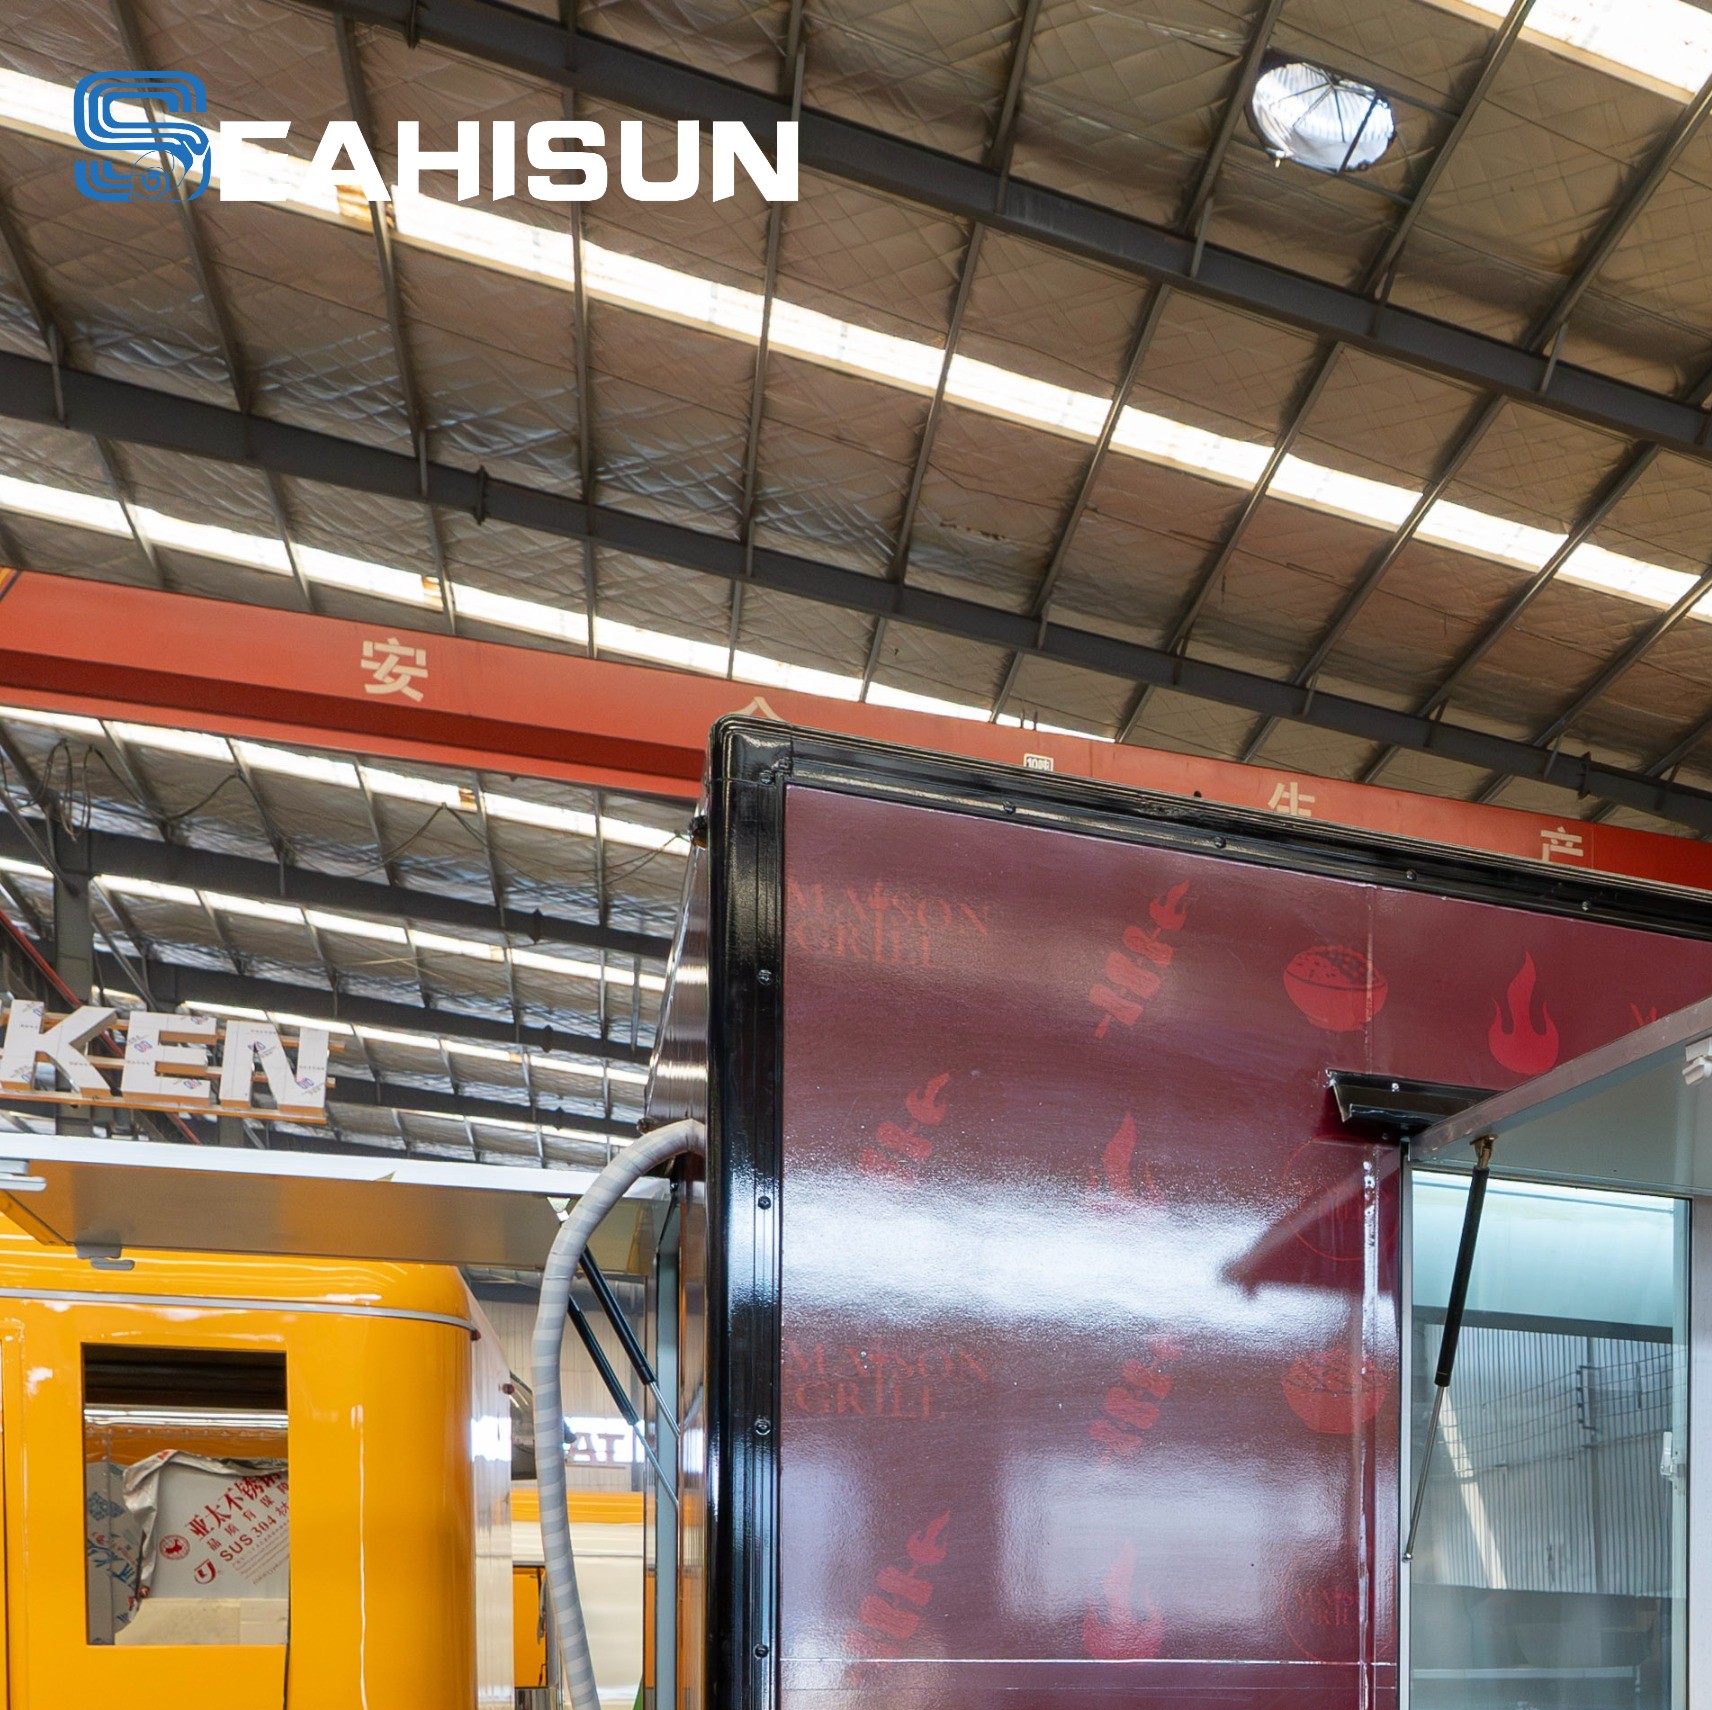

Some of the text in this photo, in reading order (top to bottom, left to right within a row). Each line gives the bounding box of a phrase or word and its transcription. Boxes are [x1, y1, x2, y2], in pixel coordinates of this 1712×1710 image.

[360, 636, 1584, 861] 安 生 产
[786, 880, 990, 935] MAISON
[0, 999, 329, 1113] KEN
[220, 1533, 253, 1561] SUS
[251, 1515, 276, 1538] 304
